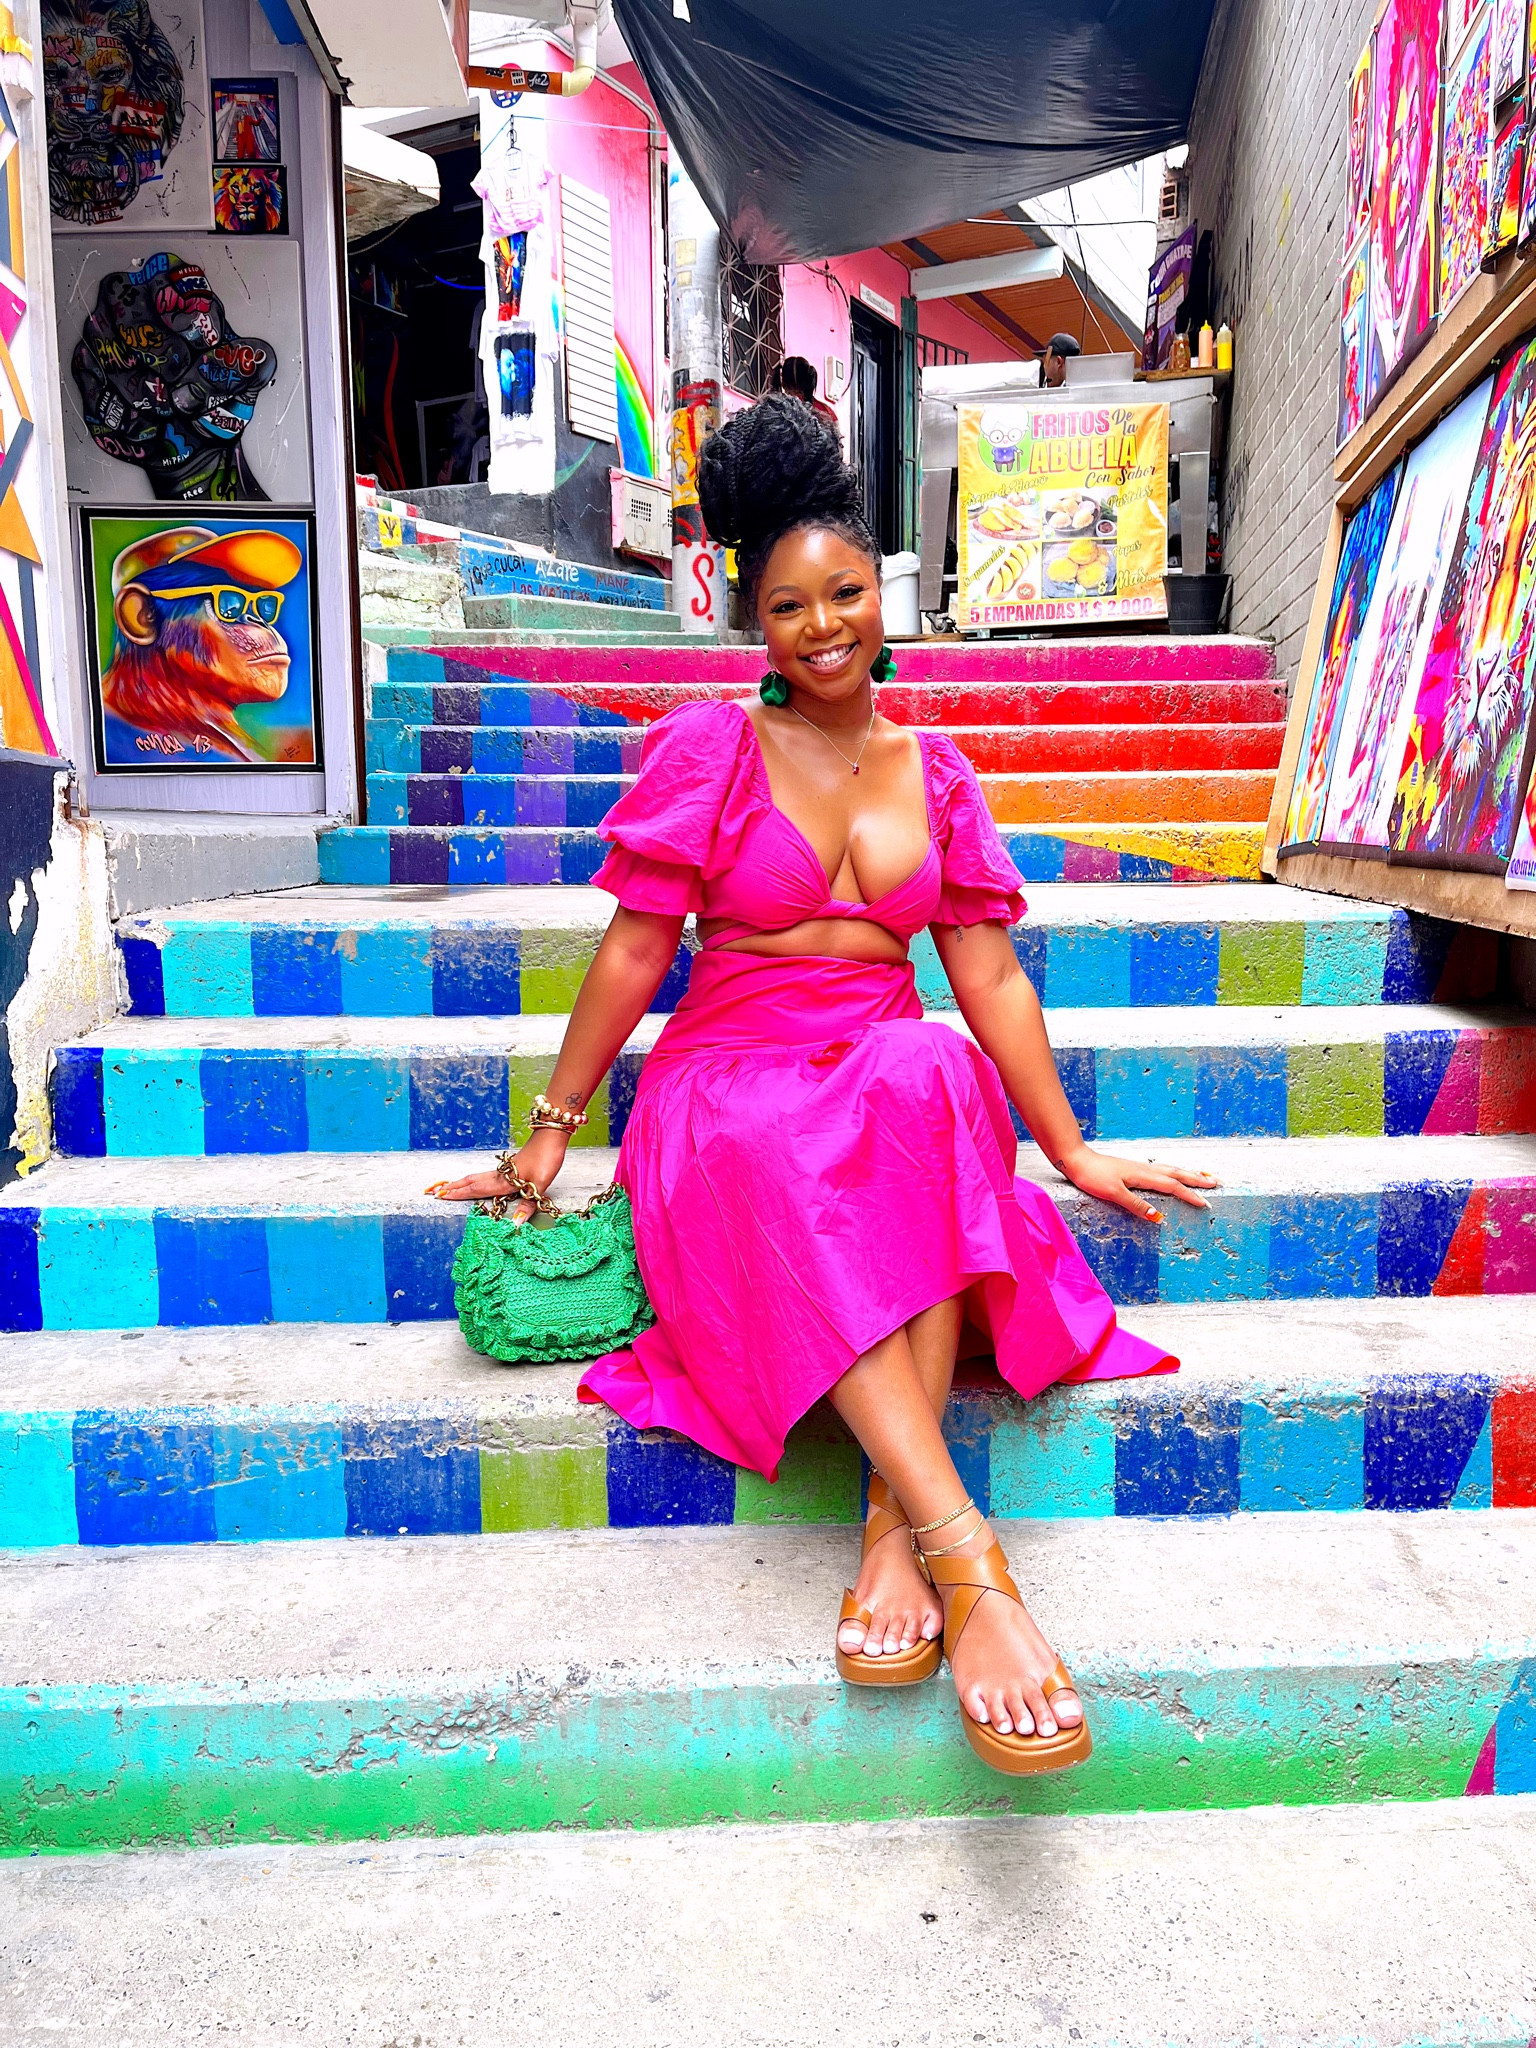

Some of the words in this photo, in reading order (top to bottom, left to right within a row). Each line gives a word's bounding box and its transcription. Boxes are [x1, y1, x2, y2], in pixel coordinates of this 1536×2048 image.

[1031, 408, 1111, 439] FRITOS
[1111, 408, 1134, 422] De
[1122, 421, 1138, 436] la
[1028, 434, 1139, 475] ABUELA
[1085, 471, 1112, 489] Con
[1114, 464, 1156, 487] Sabor
[970, 606, 980, 623] 5
[984, 602, 1076, 623] EMPANADAS
[1092, 600, 1103, 618] $
[1107, 596, 1153, 617] 2.000
[193, 734, 212, 754] 13
